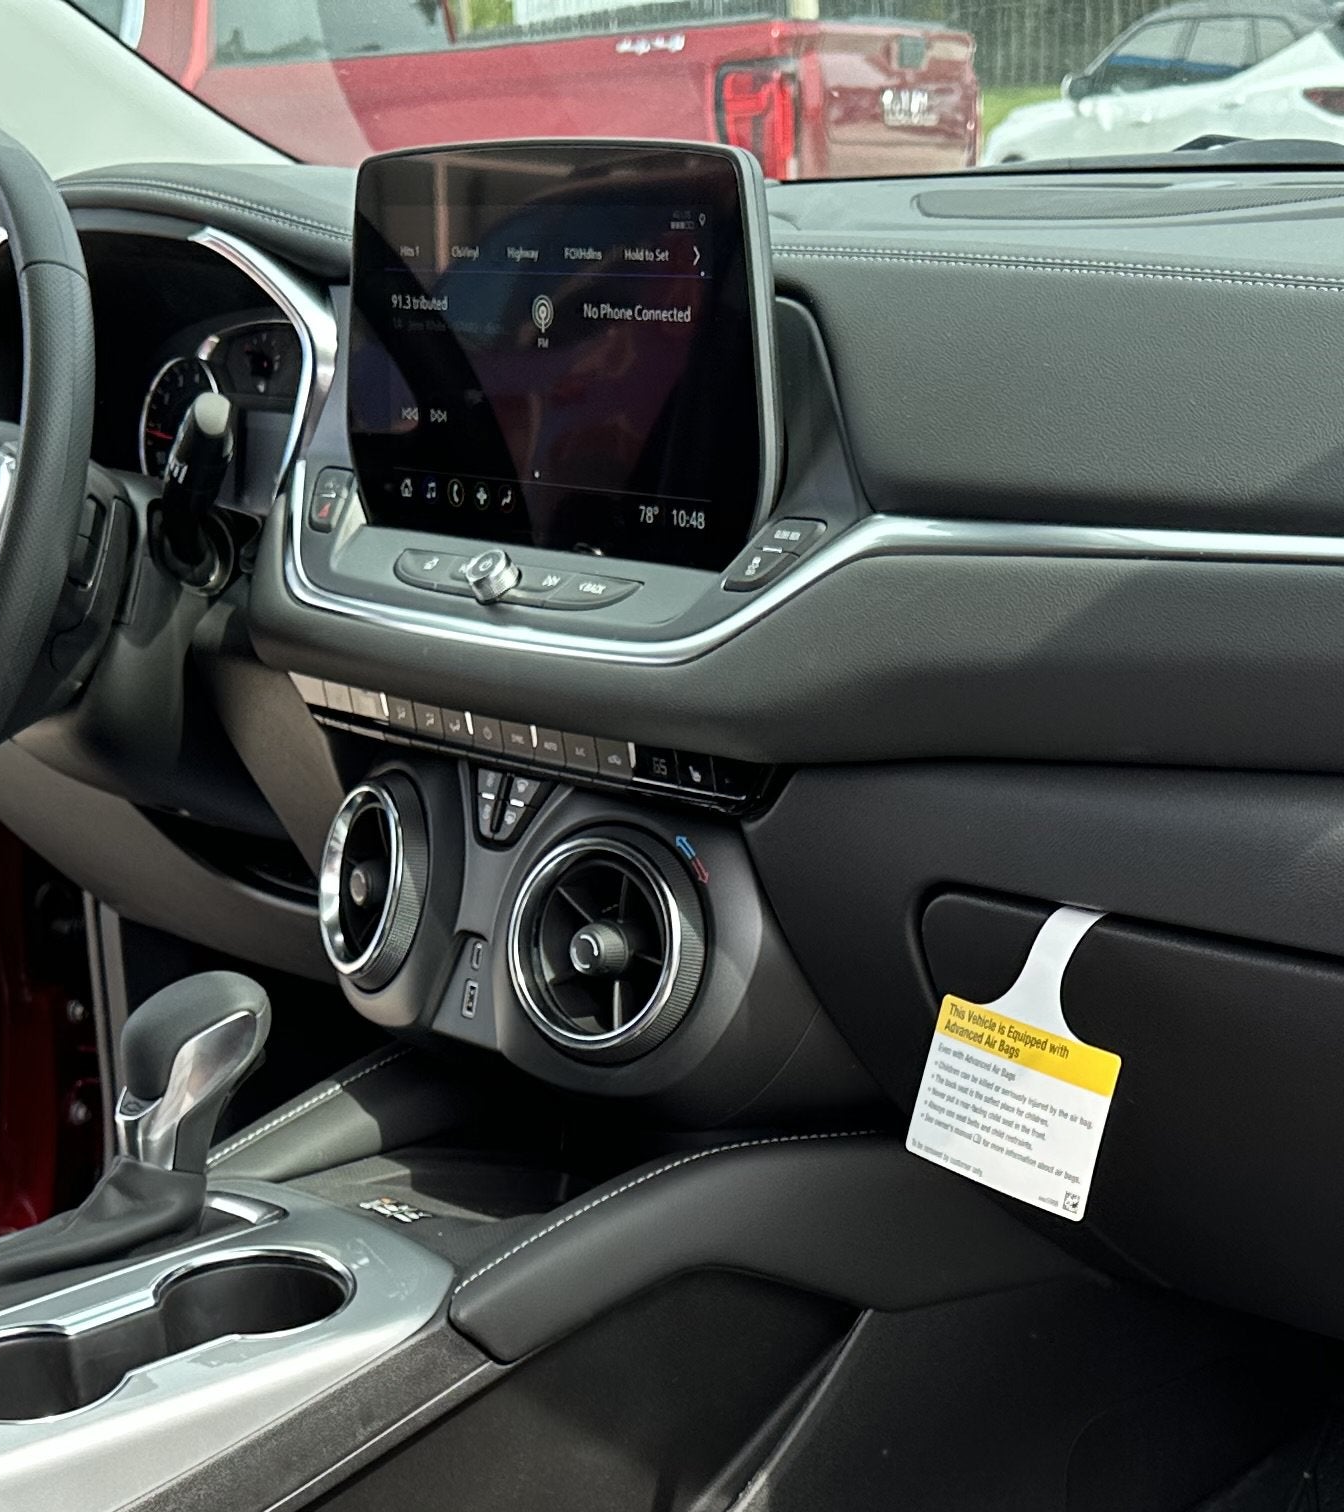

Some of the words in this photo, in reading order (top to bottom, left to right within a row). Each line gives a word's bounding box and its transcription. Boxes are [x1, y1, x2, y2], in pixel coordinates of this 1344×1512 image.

[507, 247, 539, 262] Highway
[624, 249, 643, 261] Hold
[645, 250, 654, 261] to
[655, 249, 669, 263] Set
[391, 294, 411, 310] 91.3
[583, 303, 598, 320] No
[600, 304, 632, 321] Phone
[634, 305, 691, 323] Connected
[537, 338, 549, 349] FM
[672, 509, 705, 529] 10:48
[944, 1019, 984, 1044] Advanced
[984, 1035, 997, 1049] Air
[998, 1039, 1020, 1059] Bags
[949, 1003, 966, 1021] This
[967, 1010, 997, 1032] Vehicle
[997, 1022, 1006, 1036] is
[1007, 1026, 1048, 1051] Equipped
[1049, 1043, 1069, 1059] with
[964, 1054, 992, 1071] Advanced
[1000, 1068, 1016, 1082] Bags
[1027, 1097, 1049, 1112] injured
[1049, 1105, 1058, 1117] by
[1058, 1109, 1069, 1119] the
[1069, 1114, 1079, 1123] air
